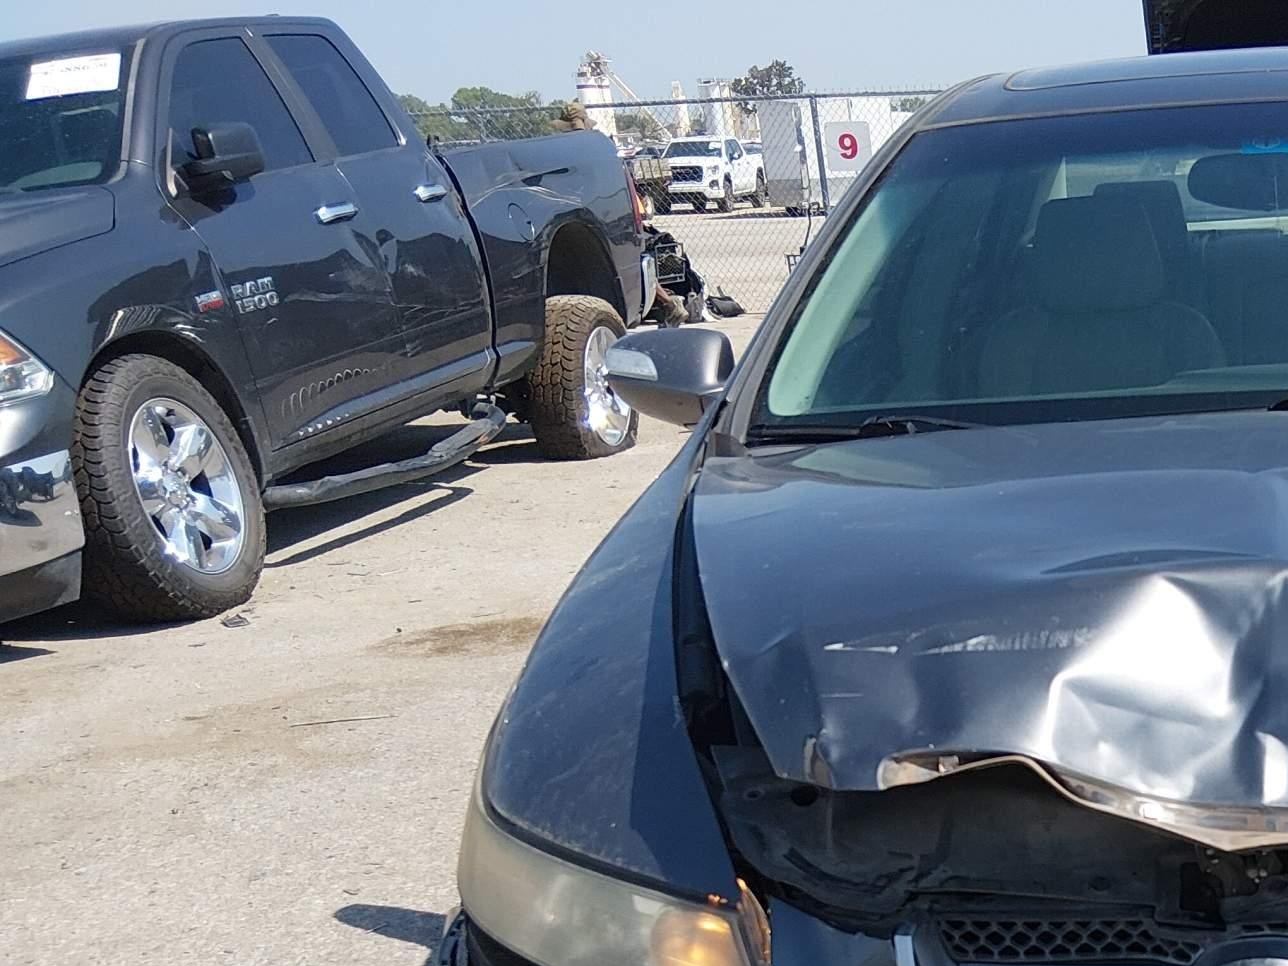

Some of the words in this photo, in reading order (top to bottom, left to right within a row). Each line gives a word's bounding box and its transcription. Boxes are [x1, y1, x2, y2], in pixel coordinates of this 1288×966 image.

[839, 133, 858, 160] 9
[231, 276, 274, 300] RAM
[235, 291, 280, 314] 1500
